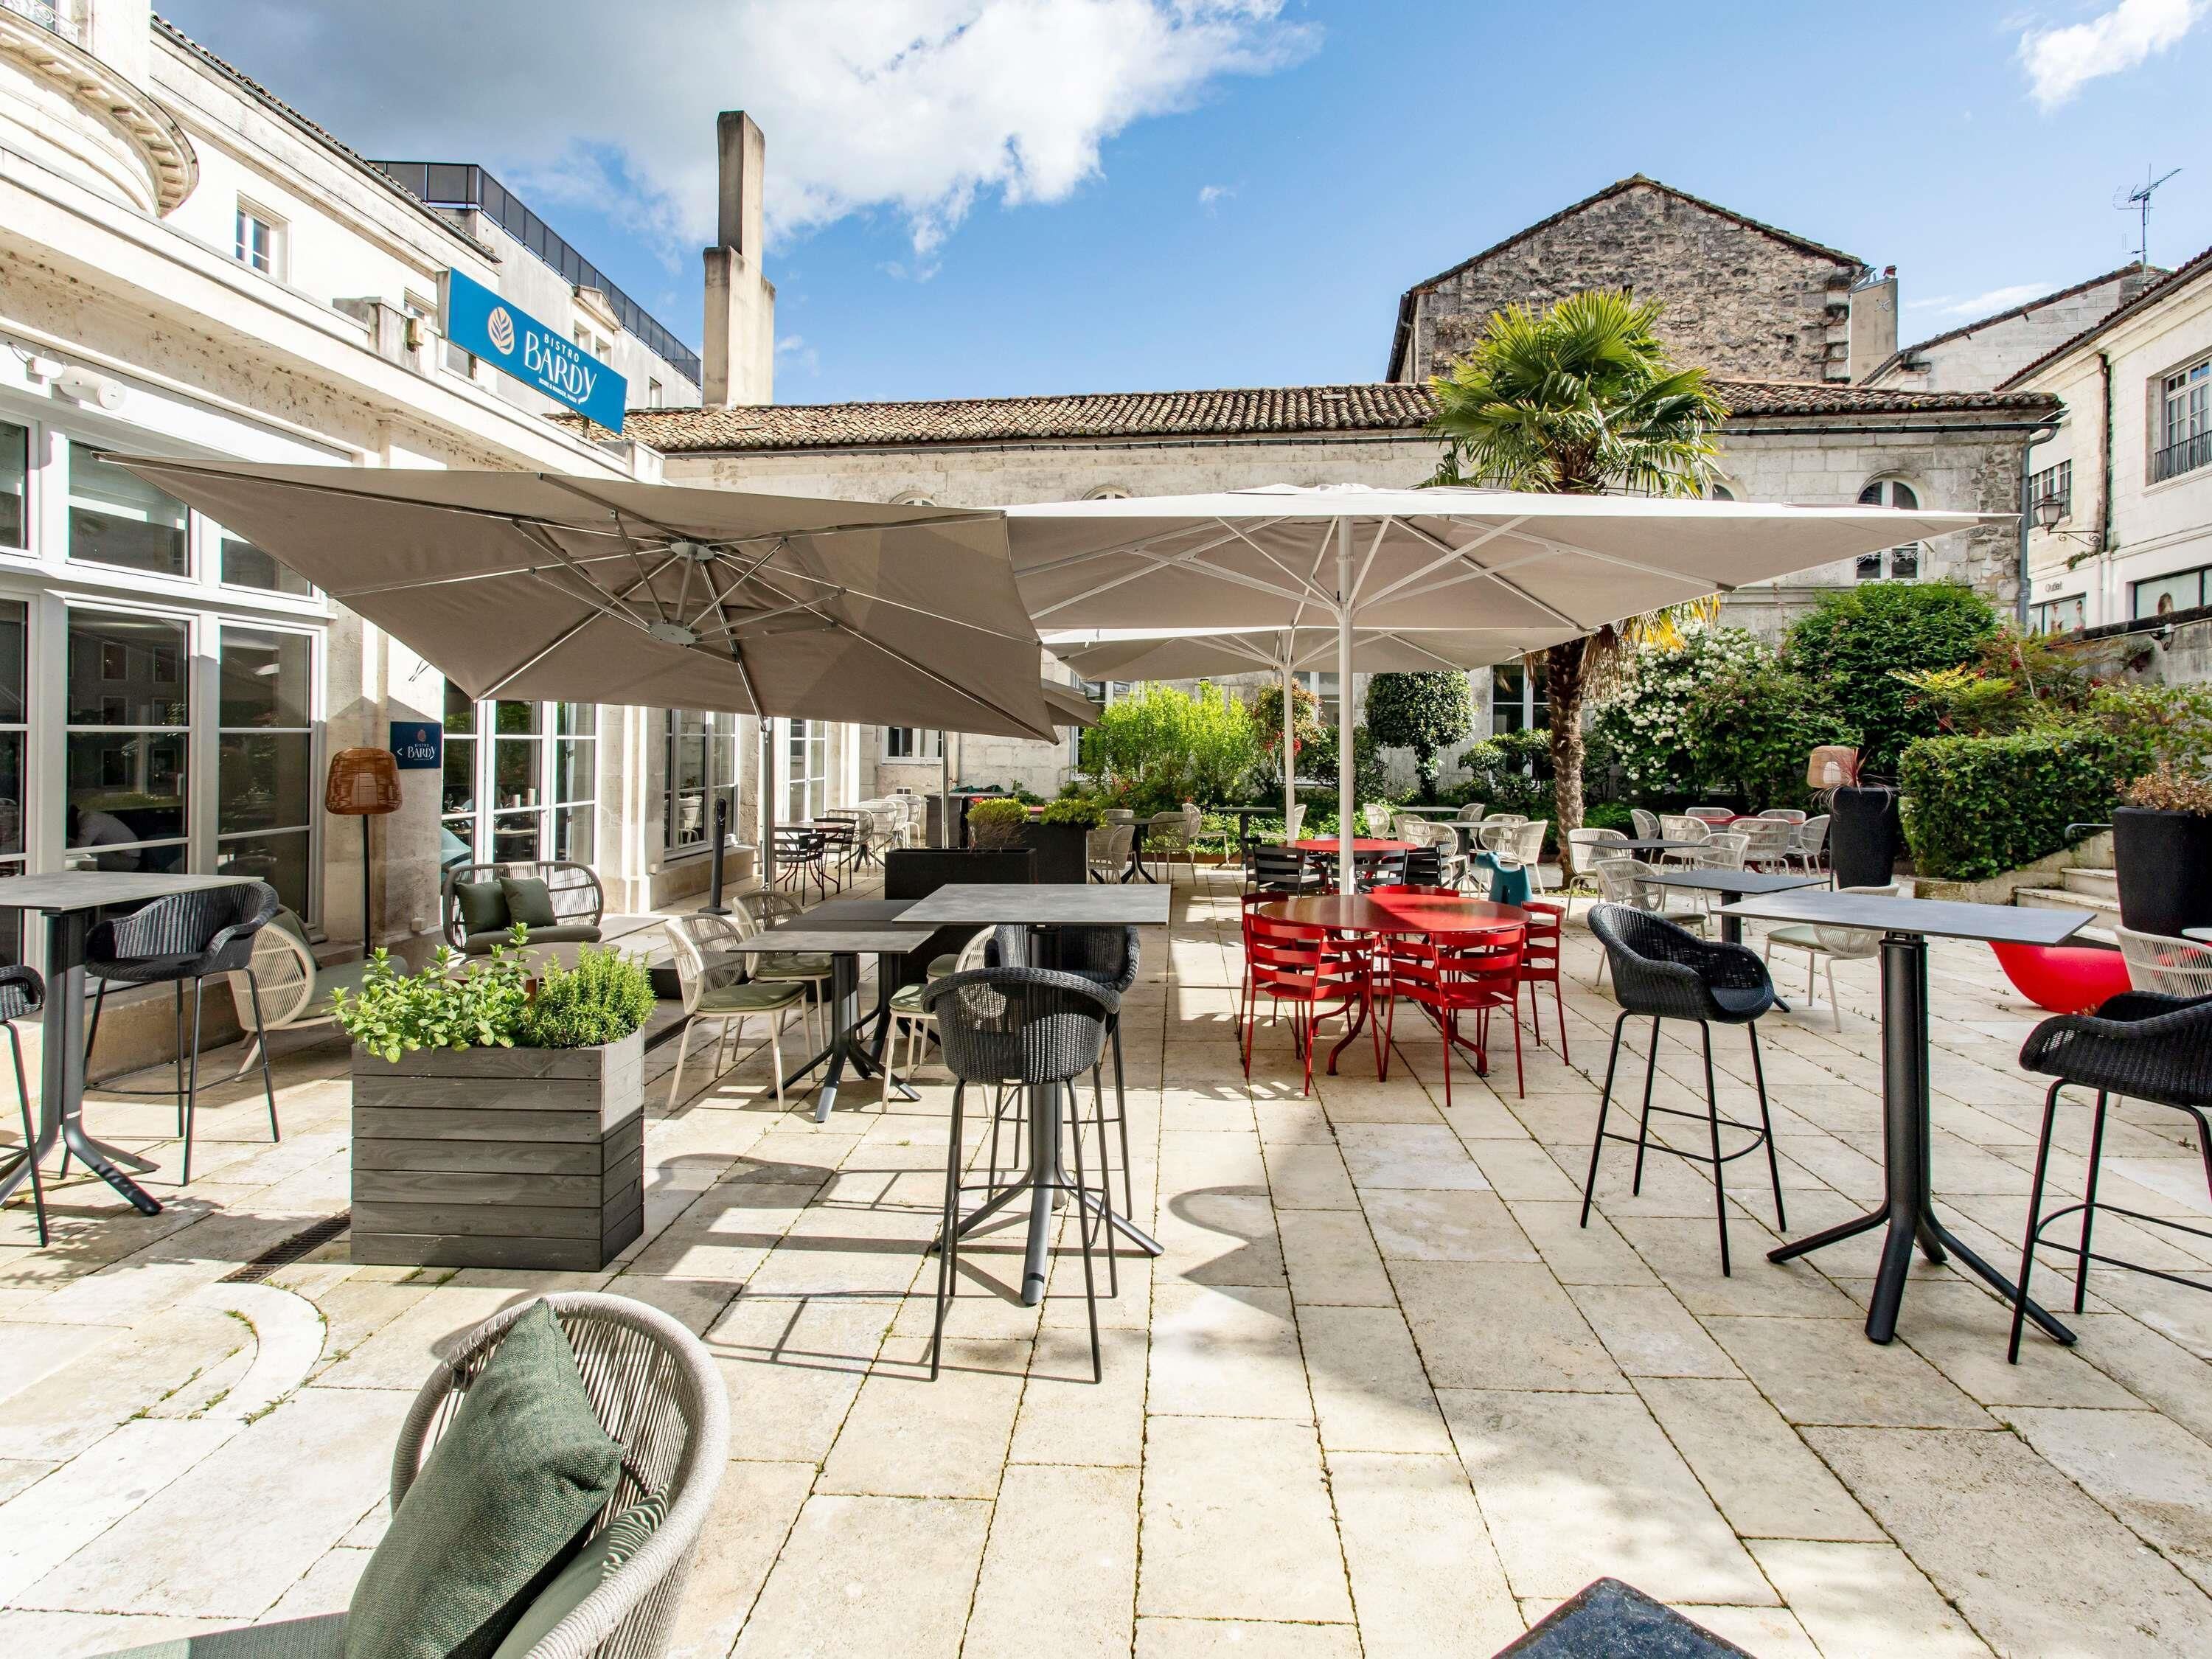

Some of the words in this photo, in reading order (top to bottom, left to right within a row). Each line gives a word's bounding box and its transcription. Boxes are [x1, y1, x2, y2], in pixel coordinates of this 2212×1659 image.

[543, 333, 580, 363] BISTRO
[524, 330, 597, 405] BARDY
[408, 745, 437, 759] BARDY
